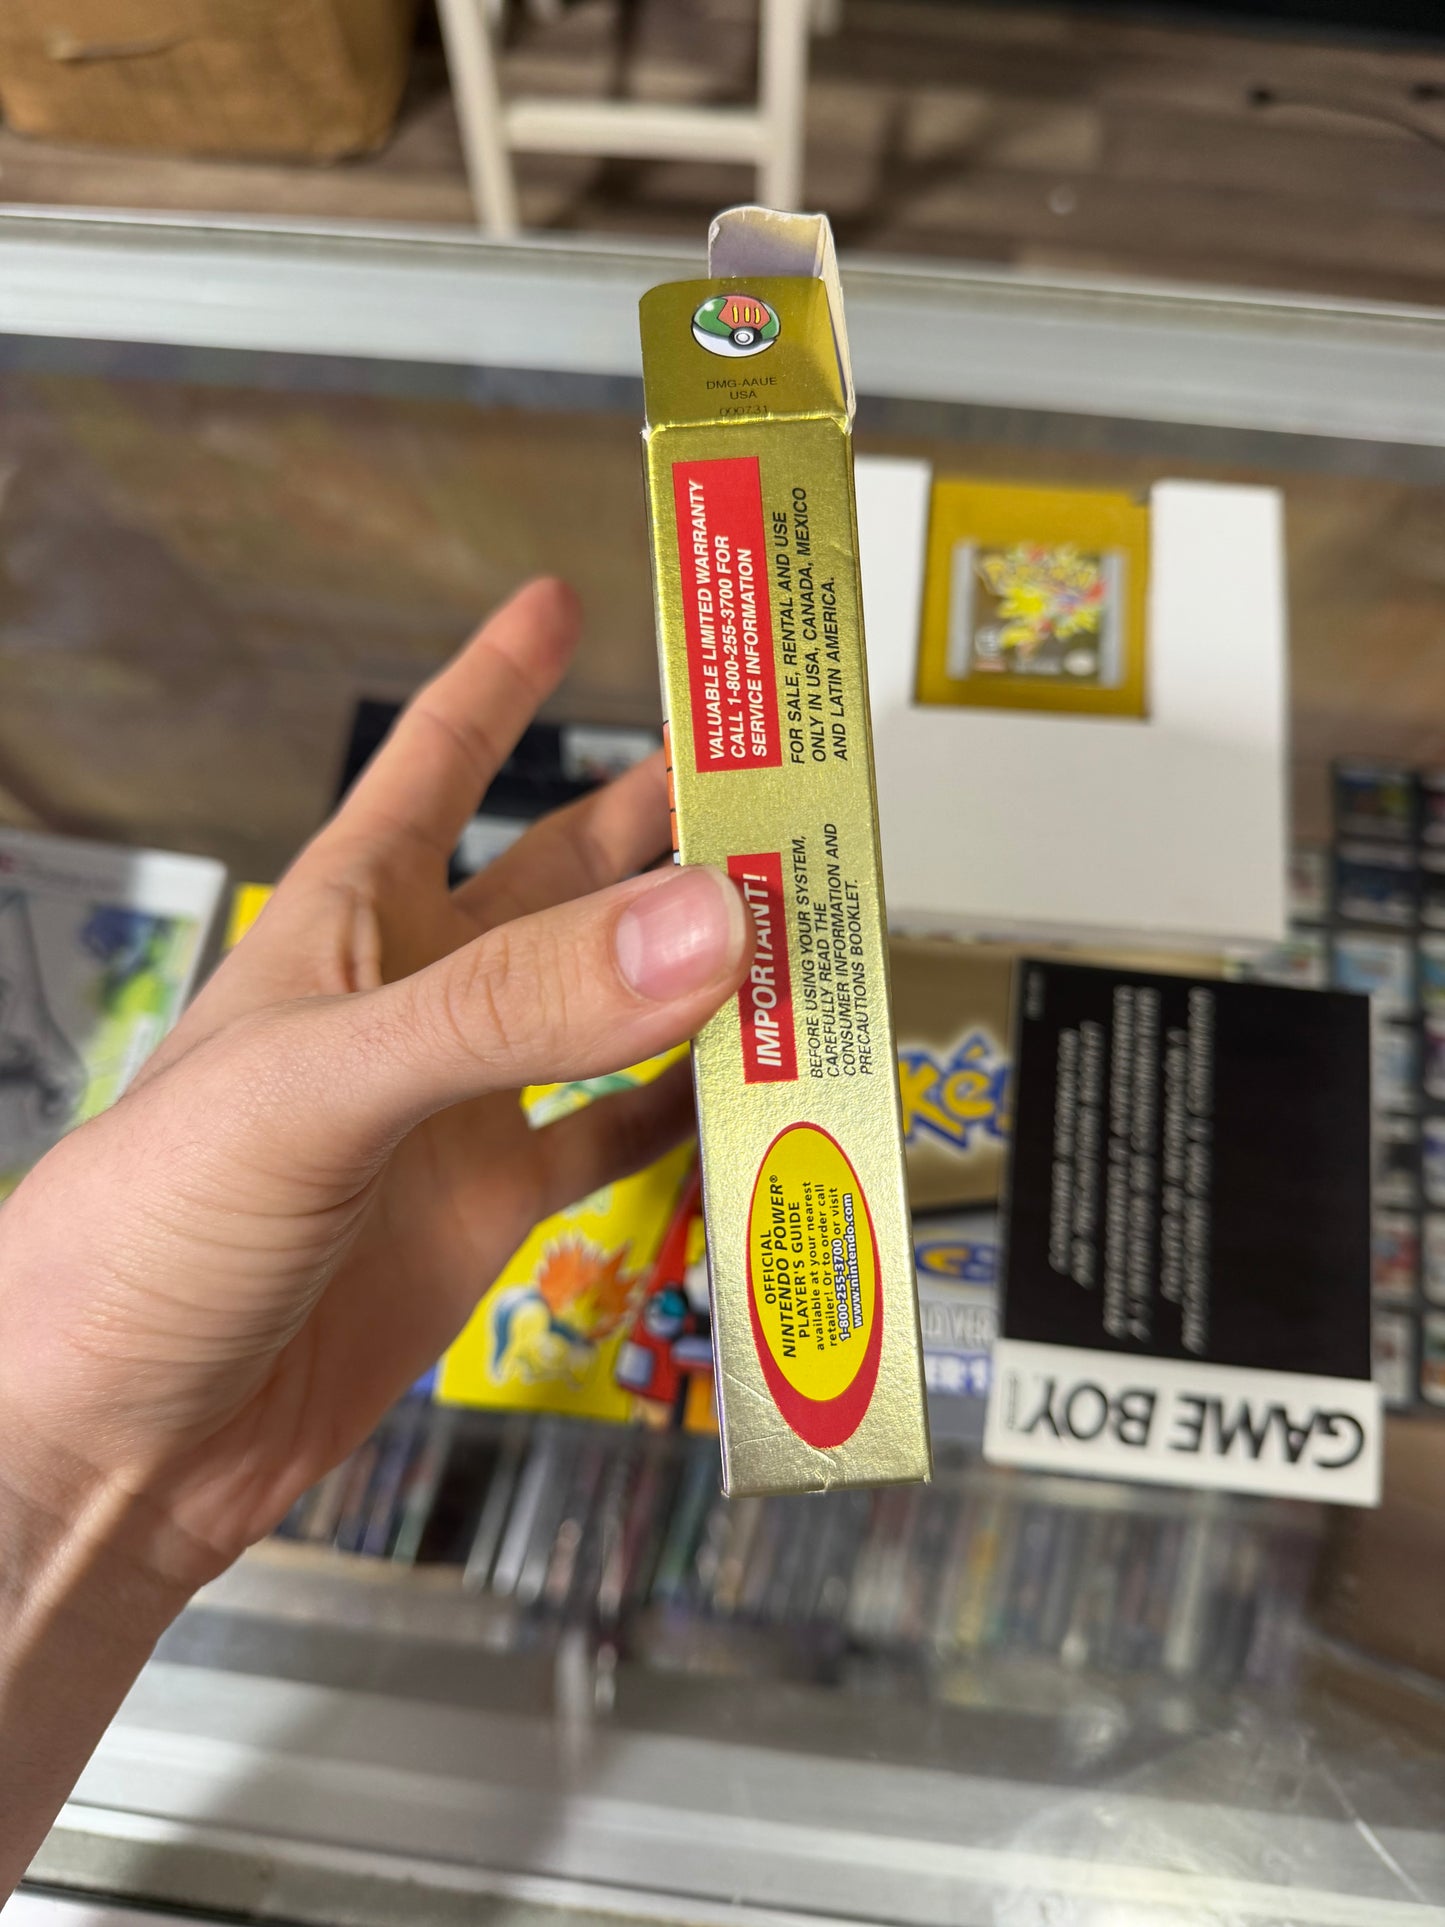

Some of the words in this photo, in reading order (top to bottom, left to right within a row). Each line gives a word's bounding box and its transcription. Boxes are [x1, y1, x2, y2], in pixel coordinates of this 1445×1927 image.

[706, 377, 778, 390] DMG-AAUE
[730, 391, 757, 399] USA
[688, 480, 712, 584] WARRANTY
[772, 512, 788, 547] USE
[792, 488, 810, 556] MEXICO
[715, 536, 731, 574] FOR
[775, 554, 790, 591] AND
[697, 588, 717, 660] LIMITED
[738, 548, 761, 674] INFORMATION
[798, 562, 817, 641] CANADA,
[821, 577, 840, 662] AMERICA.
[720, 578, 743, 706] 1-800-255-3700
[779, 597, 797, 666] RENTAL
[804, 647, 821, 687] USA,
[703, 666, 725, 759] VALUABLE
[785, 672, 801, 722] SALE,
[808, 694, 821, 711] IN
[827, 668, 844, 717] LATIN
[730, 711, 746, 758] CALL
[748, 680, 767, 757] SERVICE
[810, 717, 826, 762] ONLY
[832, 724, 848, 761] AND
[789, 728, 804, 764] FOR
[824, 823, 837, 859] AND
[792, 836, 809, 905] SYSTEM,
[798, 912, 812, 954] YOUR
[813, 903, 827, 933] THE
[827, 864, 849, 976] INFORMATION
[845, 880, 863, 956] BOOKLET.
[802, 960, 818, 1010] USING
[817, 939, 831, 982] READ
[820, 989, 839, 1077] CAREFULLY
[837, 983, 856, 1076] CONSUMER
[853, 962, 873, 1075] PRECAUTIONS
[807, 1018, 823, 1078] BEFORE
[802, 1182, 815, 1231] nearest
[815, 1184, 825, 1206] call
[829, 1187, 839, 1216] visit
[788, 1202, 803, 1253] GUIDE
[807, 1236, 819, 1266] your
[817, 1210, 829, 1247] order
[832, 1220, 841, 1235] or
[760, 1230, 776, 1304] OFFICIAL
[809, 1271, 819, 1284] at
[821, 1252, 830, 1266] to
[822, 1271, 832, 1286] Or
[842, 1193, 863, 1328] www.nintendo.com
[776, 1258, 796, 1358] NINTENDO
[793, 1260, 810, 1338] PLAYER'S
[831, 1239, 850, 1341] 1-800-255-3700
[811, 1289, 825, 1351] available
[824, 1291, 838, 1346] retailer!
[1022, 1380, 1156, 1447] BOY
[1172, 1395, 1365, 1470] GAME
